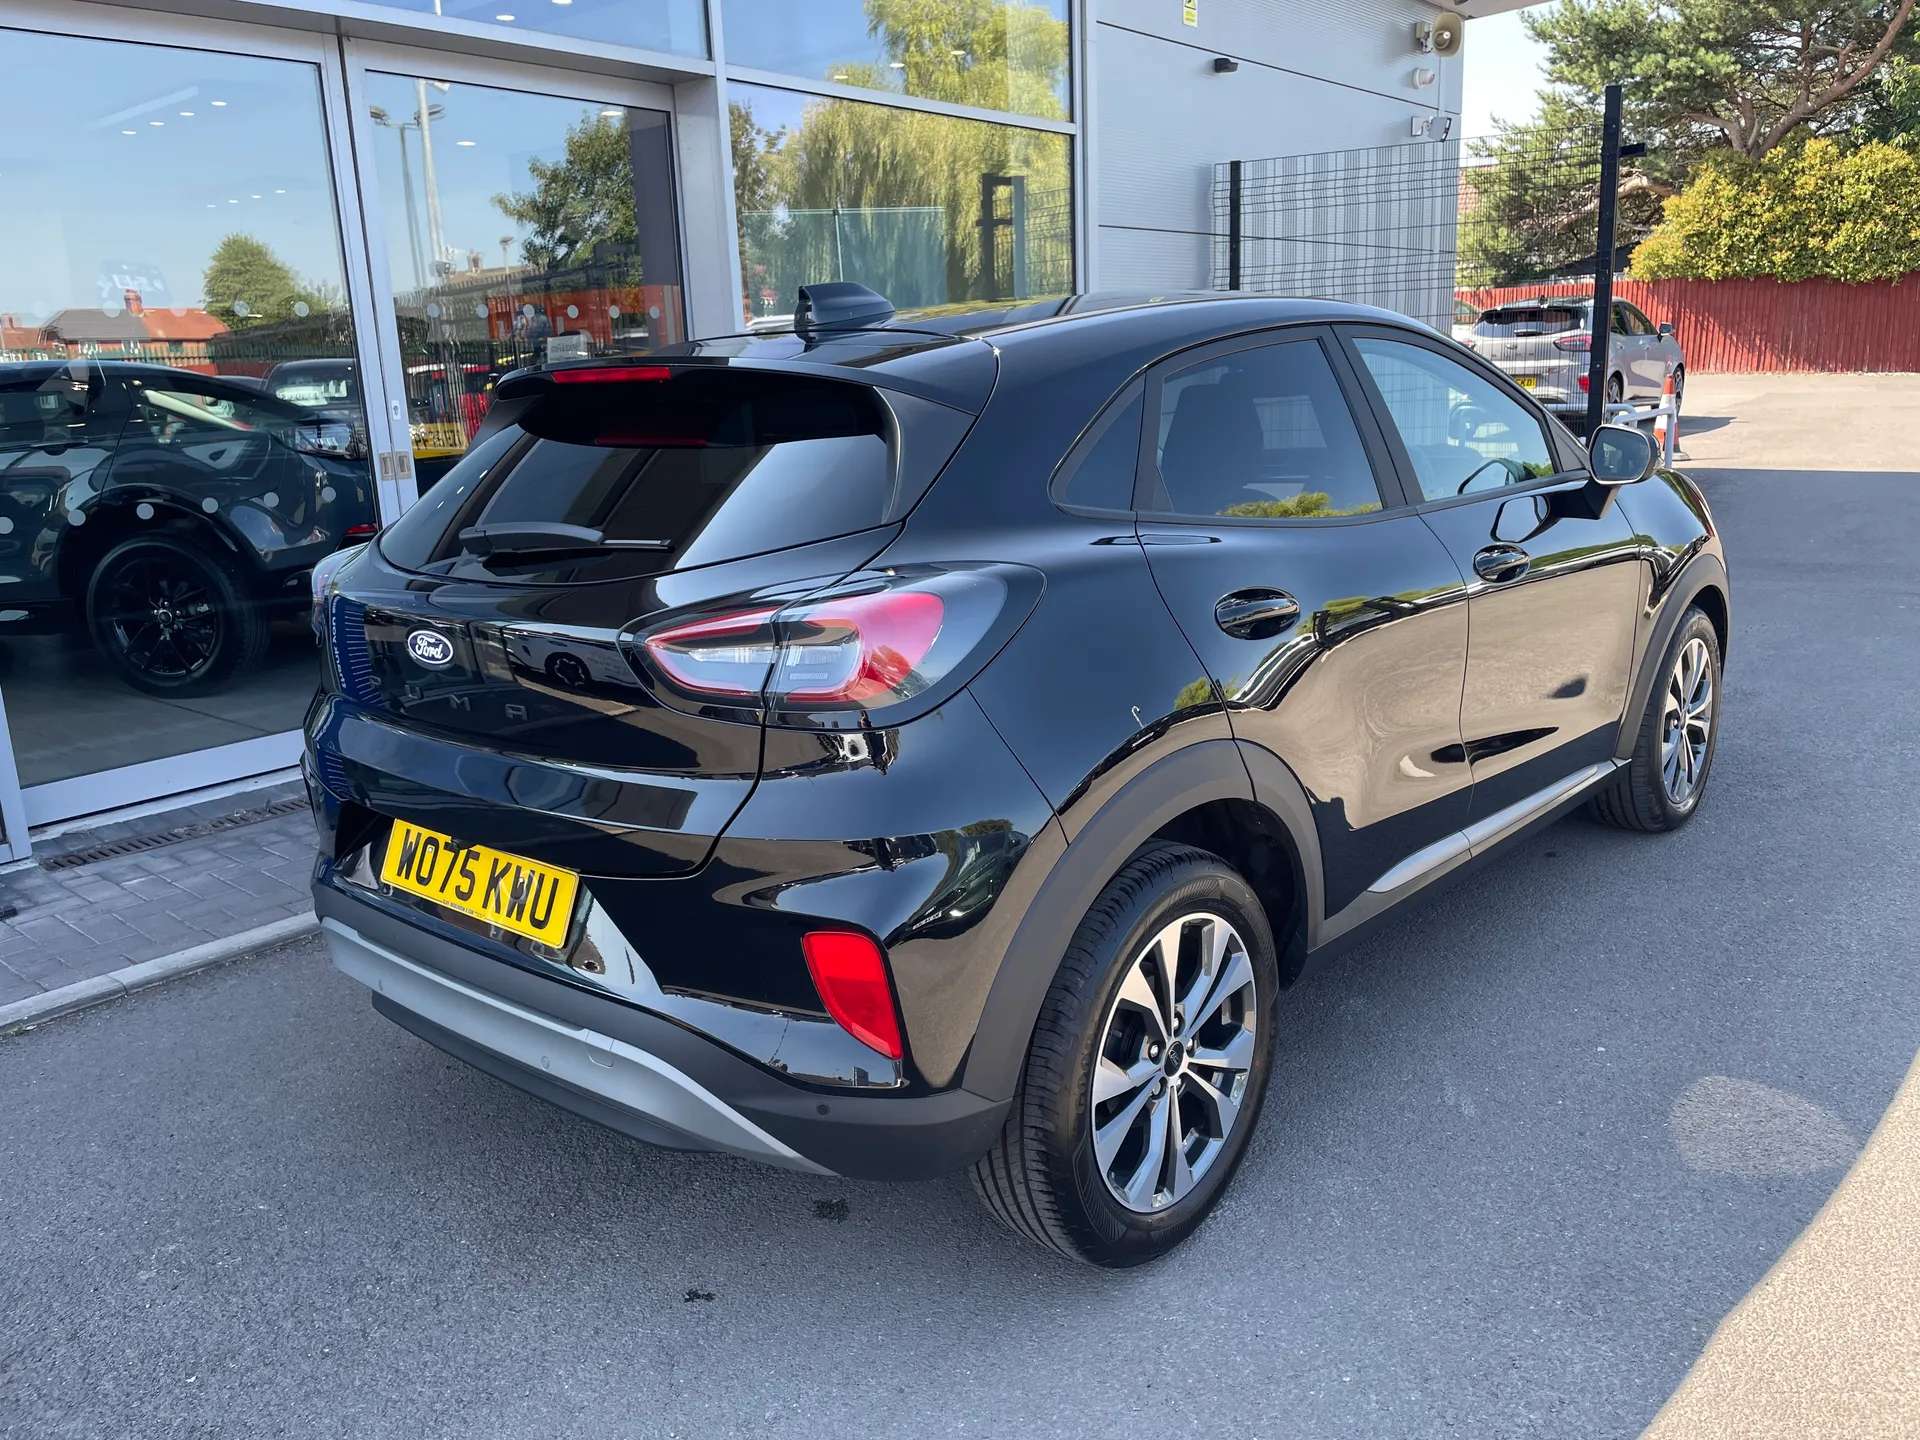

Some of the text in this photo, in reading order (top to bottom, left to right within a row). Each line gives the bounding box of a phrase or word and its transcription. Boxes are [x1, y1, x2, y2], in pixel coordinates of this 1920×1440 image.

[413, 633, 445, 661] Ford
[396, 828, 559, 930] WO75 KWU
